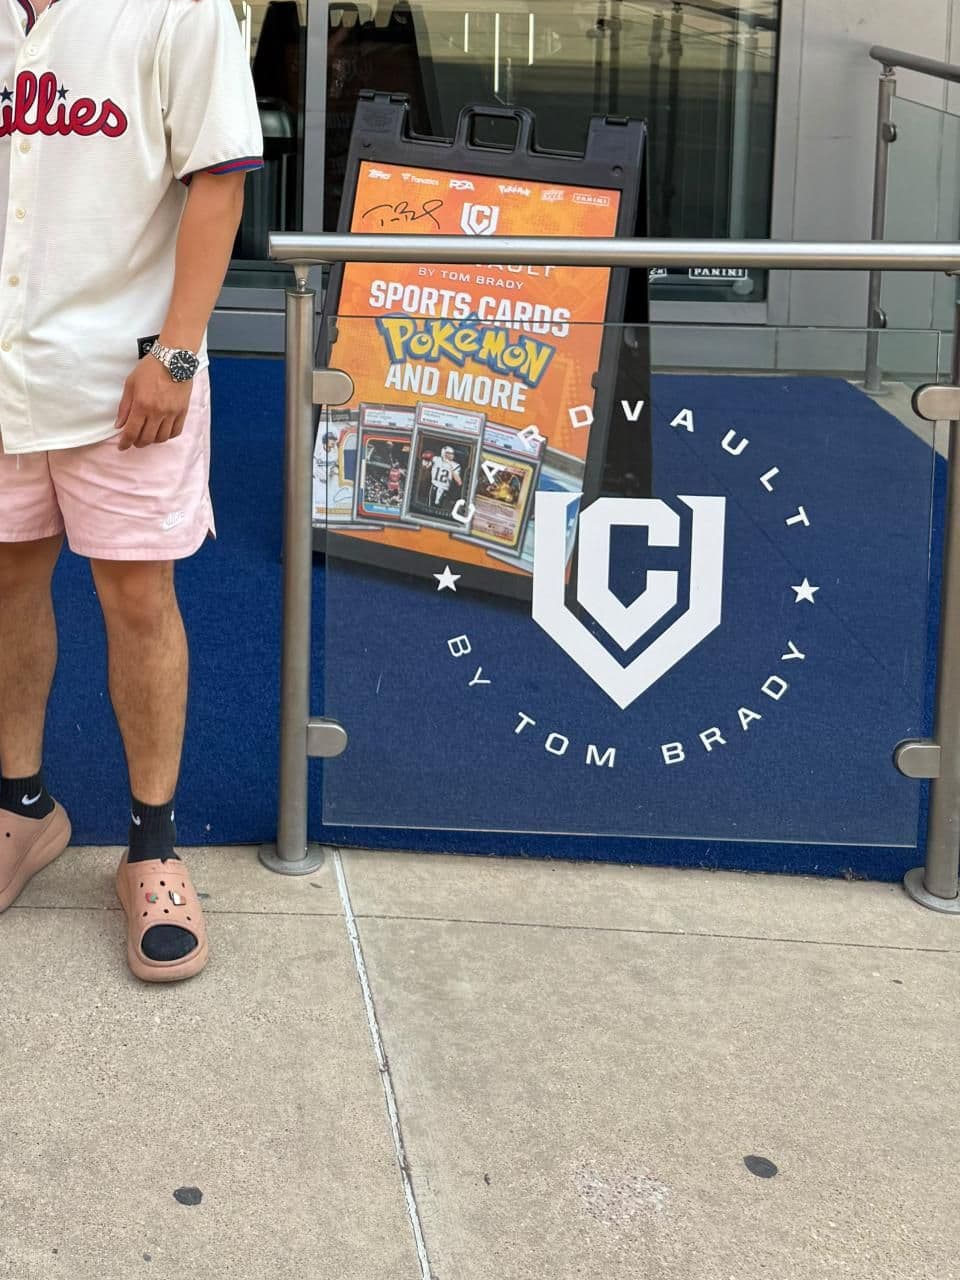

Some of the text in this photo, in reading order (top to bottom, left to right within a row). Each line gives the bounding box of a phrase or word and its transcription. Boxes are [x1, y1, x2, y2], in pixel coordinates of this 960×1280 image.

[418, 267, 434, 277] BY
[441, 270, 471, 282] TOM
[475, 275, 525, 290] BRADY
[368, 279, 572, 338] SPORTS CARDS
[384, 362, 529, 413] AND MORE
[451, 399, 811, 530] CARDVAULT
[447, 634, 807, 769] BY TOM BRADY
